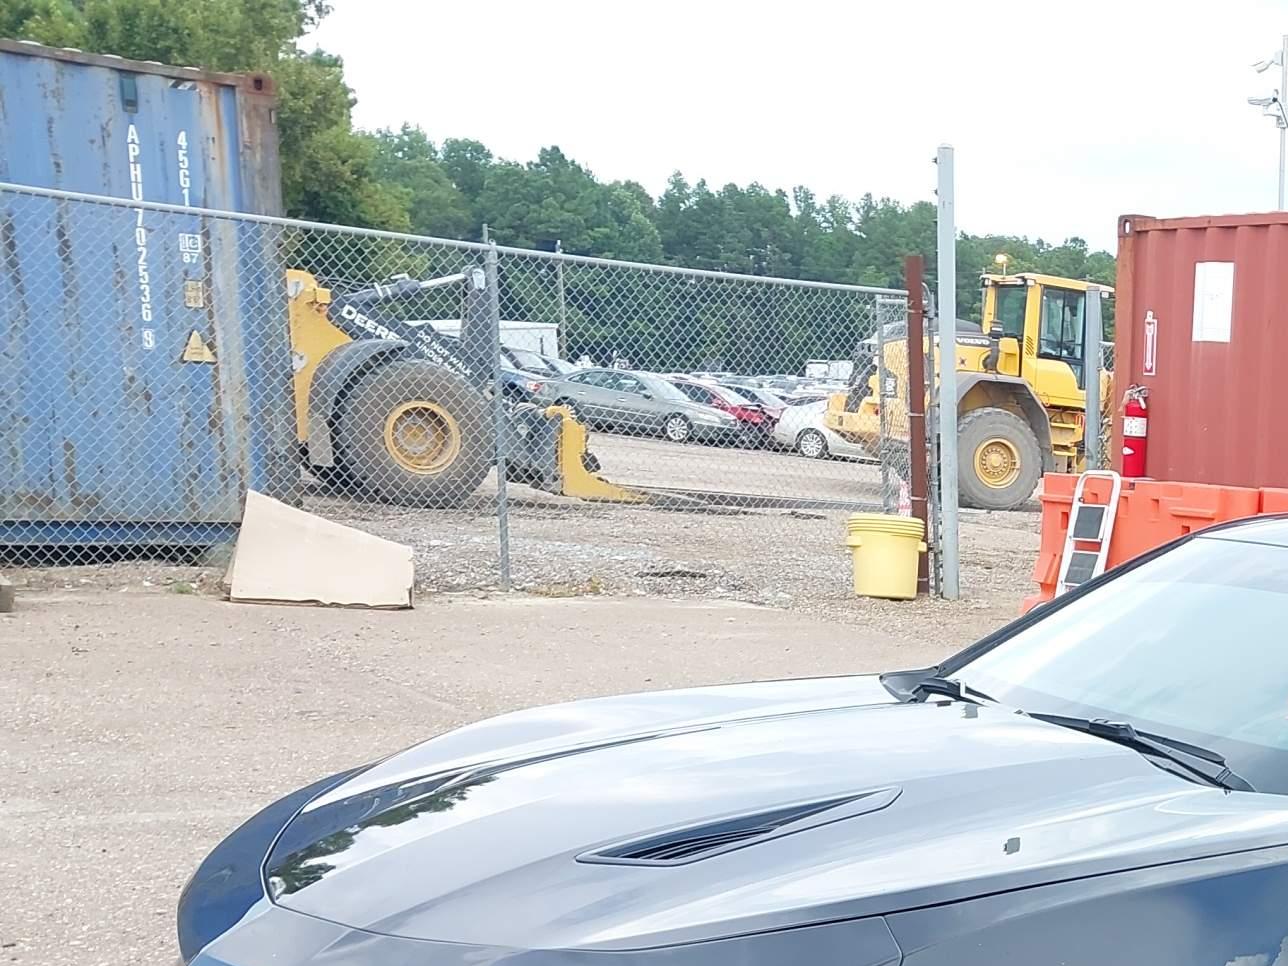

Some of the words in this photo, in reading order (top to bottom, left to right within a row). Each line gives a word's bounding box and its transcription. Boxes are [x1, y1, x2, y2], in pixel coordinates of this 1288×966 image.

[177, 130, 191, 208] 45G1
[183, 253, 200, 263] 87
[956, 337, 990, 346] VOLVO
